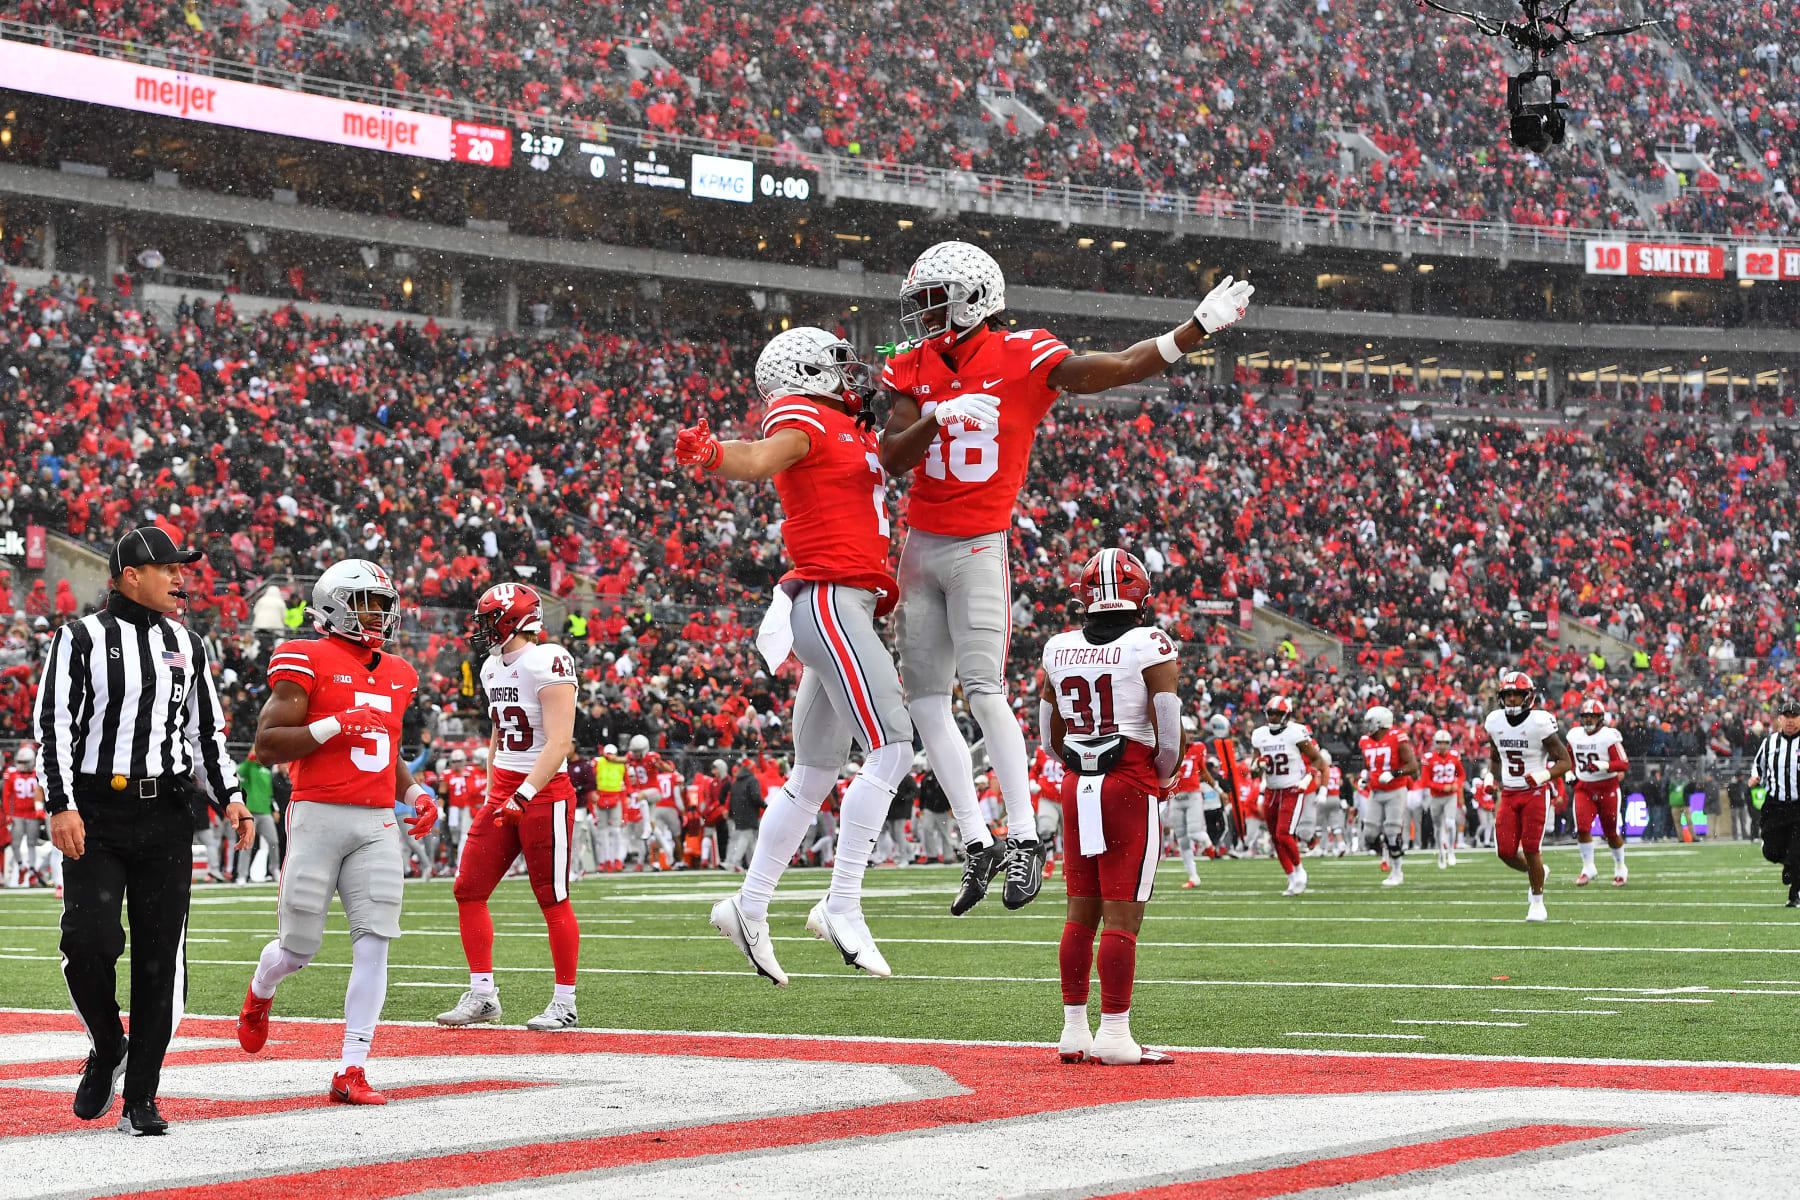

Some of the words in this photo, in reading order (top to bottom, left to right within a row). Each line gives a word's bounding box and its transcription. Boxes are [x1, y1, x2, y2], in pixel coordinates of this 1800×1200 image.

[136, 75, 216, 116] meijer
[343, 110, 419, 150] meijer
[468, 138, 494, 162] 20
[521, 132, 564, 157] 2:37
[590, 156, 605, 178] 0
[698, 173, 744, 194] KPMG
[760, 174, 809, 200] 0:00
[1595, 247, 1622, 269] 10
[1639, 247, 1710, 274] SMITH
[1746, 253, 1774, 275] 22
[921, 401, 999, 482] 18
[1100, 602, 1124, 610] INDIANA
[110, 647, 120, 659] S
[1054, 647, 1121, 667] FITZGERALD
[552, 656, 574, 677] 43
[172, 683, 184, 703] B
[1060, 673, 1119, 736] 31
[350, 691, 391, 773] 5
[491, 706, 533, 751] 43
[1364, 747, 1391, 771] 77
[1506, 751, 1525, 777] 5
[14, 778, 37, 799] 90
